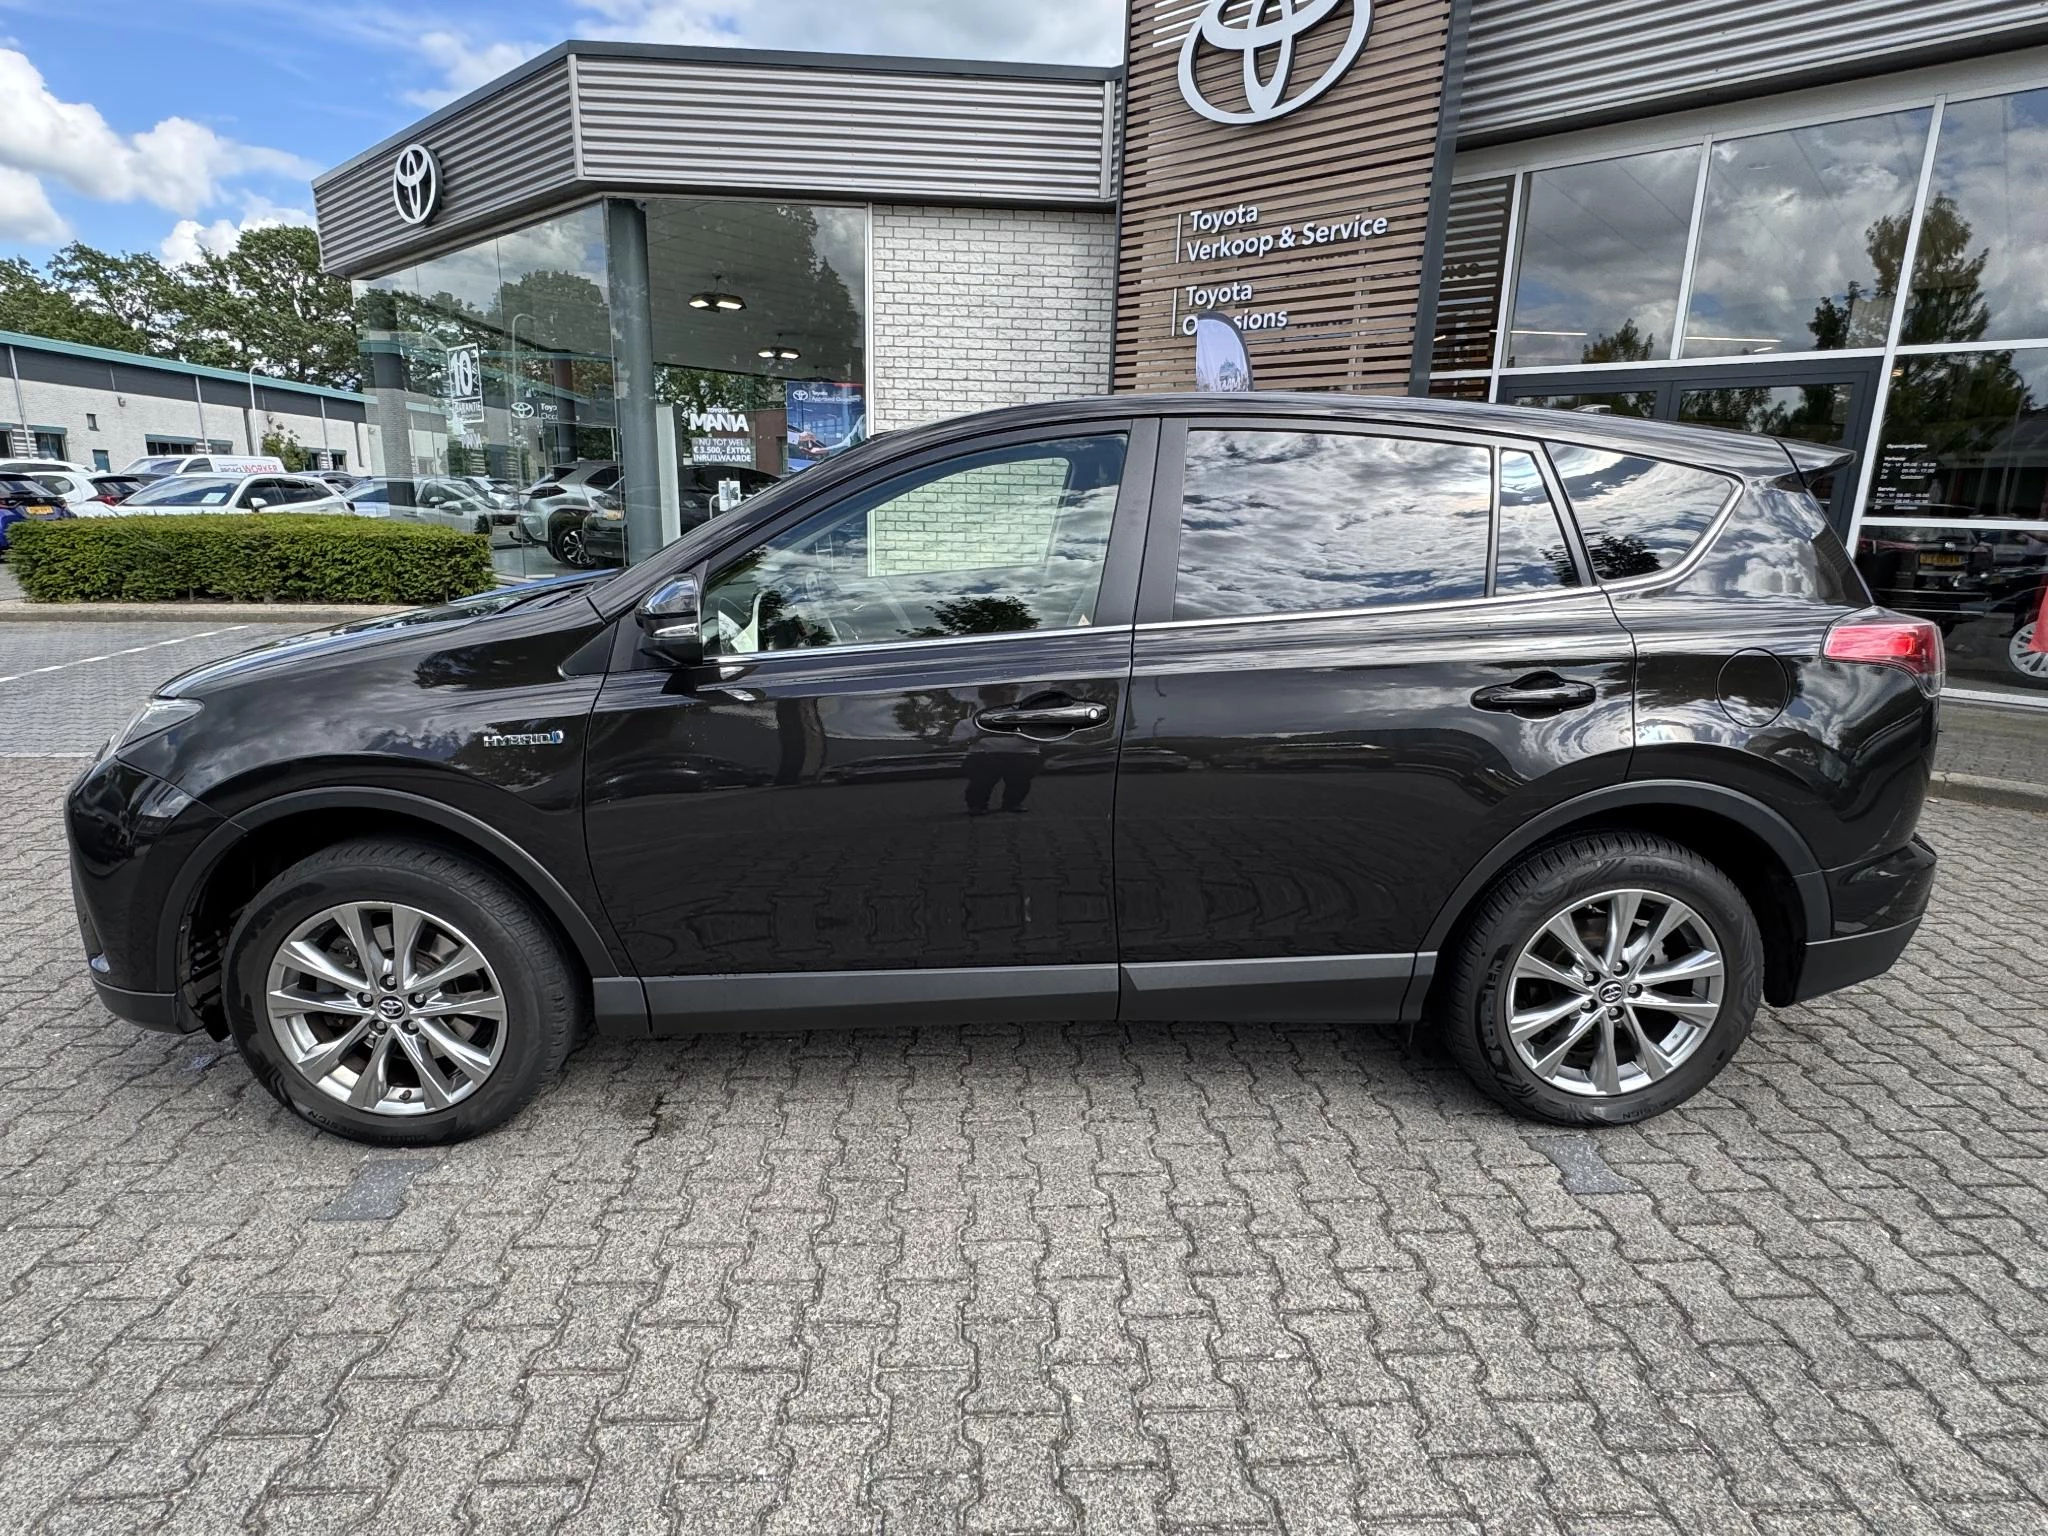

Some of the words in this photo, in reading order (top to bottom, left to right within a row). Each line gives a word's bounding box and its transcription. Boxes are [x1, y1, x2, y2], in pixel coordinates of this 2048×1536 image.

[1190, 204, 1258, 233] Toyota
[1187, 234, 1274, 262] Verkoop
[1278, 225, 1296, 248] &
[1302, 214, 1388, 245] Service
[1185, 282, 1253, 309] Toyota
[1182, 309, 1288, 336] Osions
[451, 351, 472, 397] 10
[689, 413, 750, 432] MANIA
[713, 438, 726, 446] TOT
[728, 438, 744, 446] WEL
[693, 455, 752, 463] INRUILWAARDE
[483, 734, 550, 747] HYBRID
